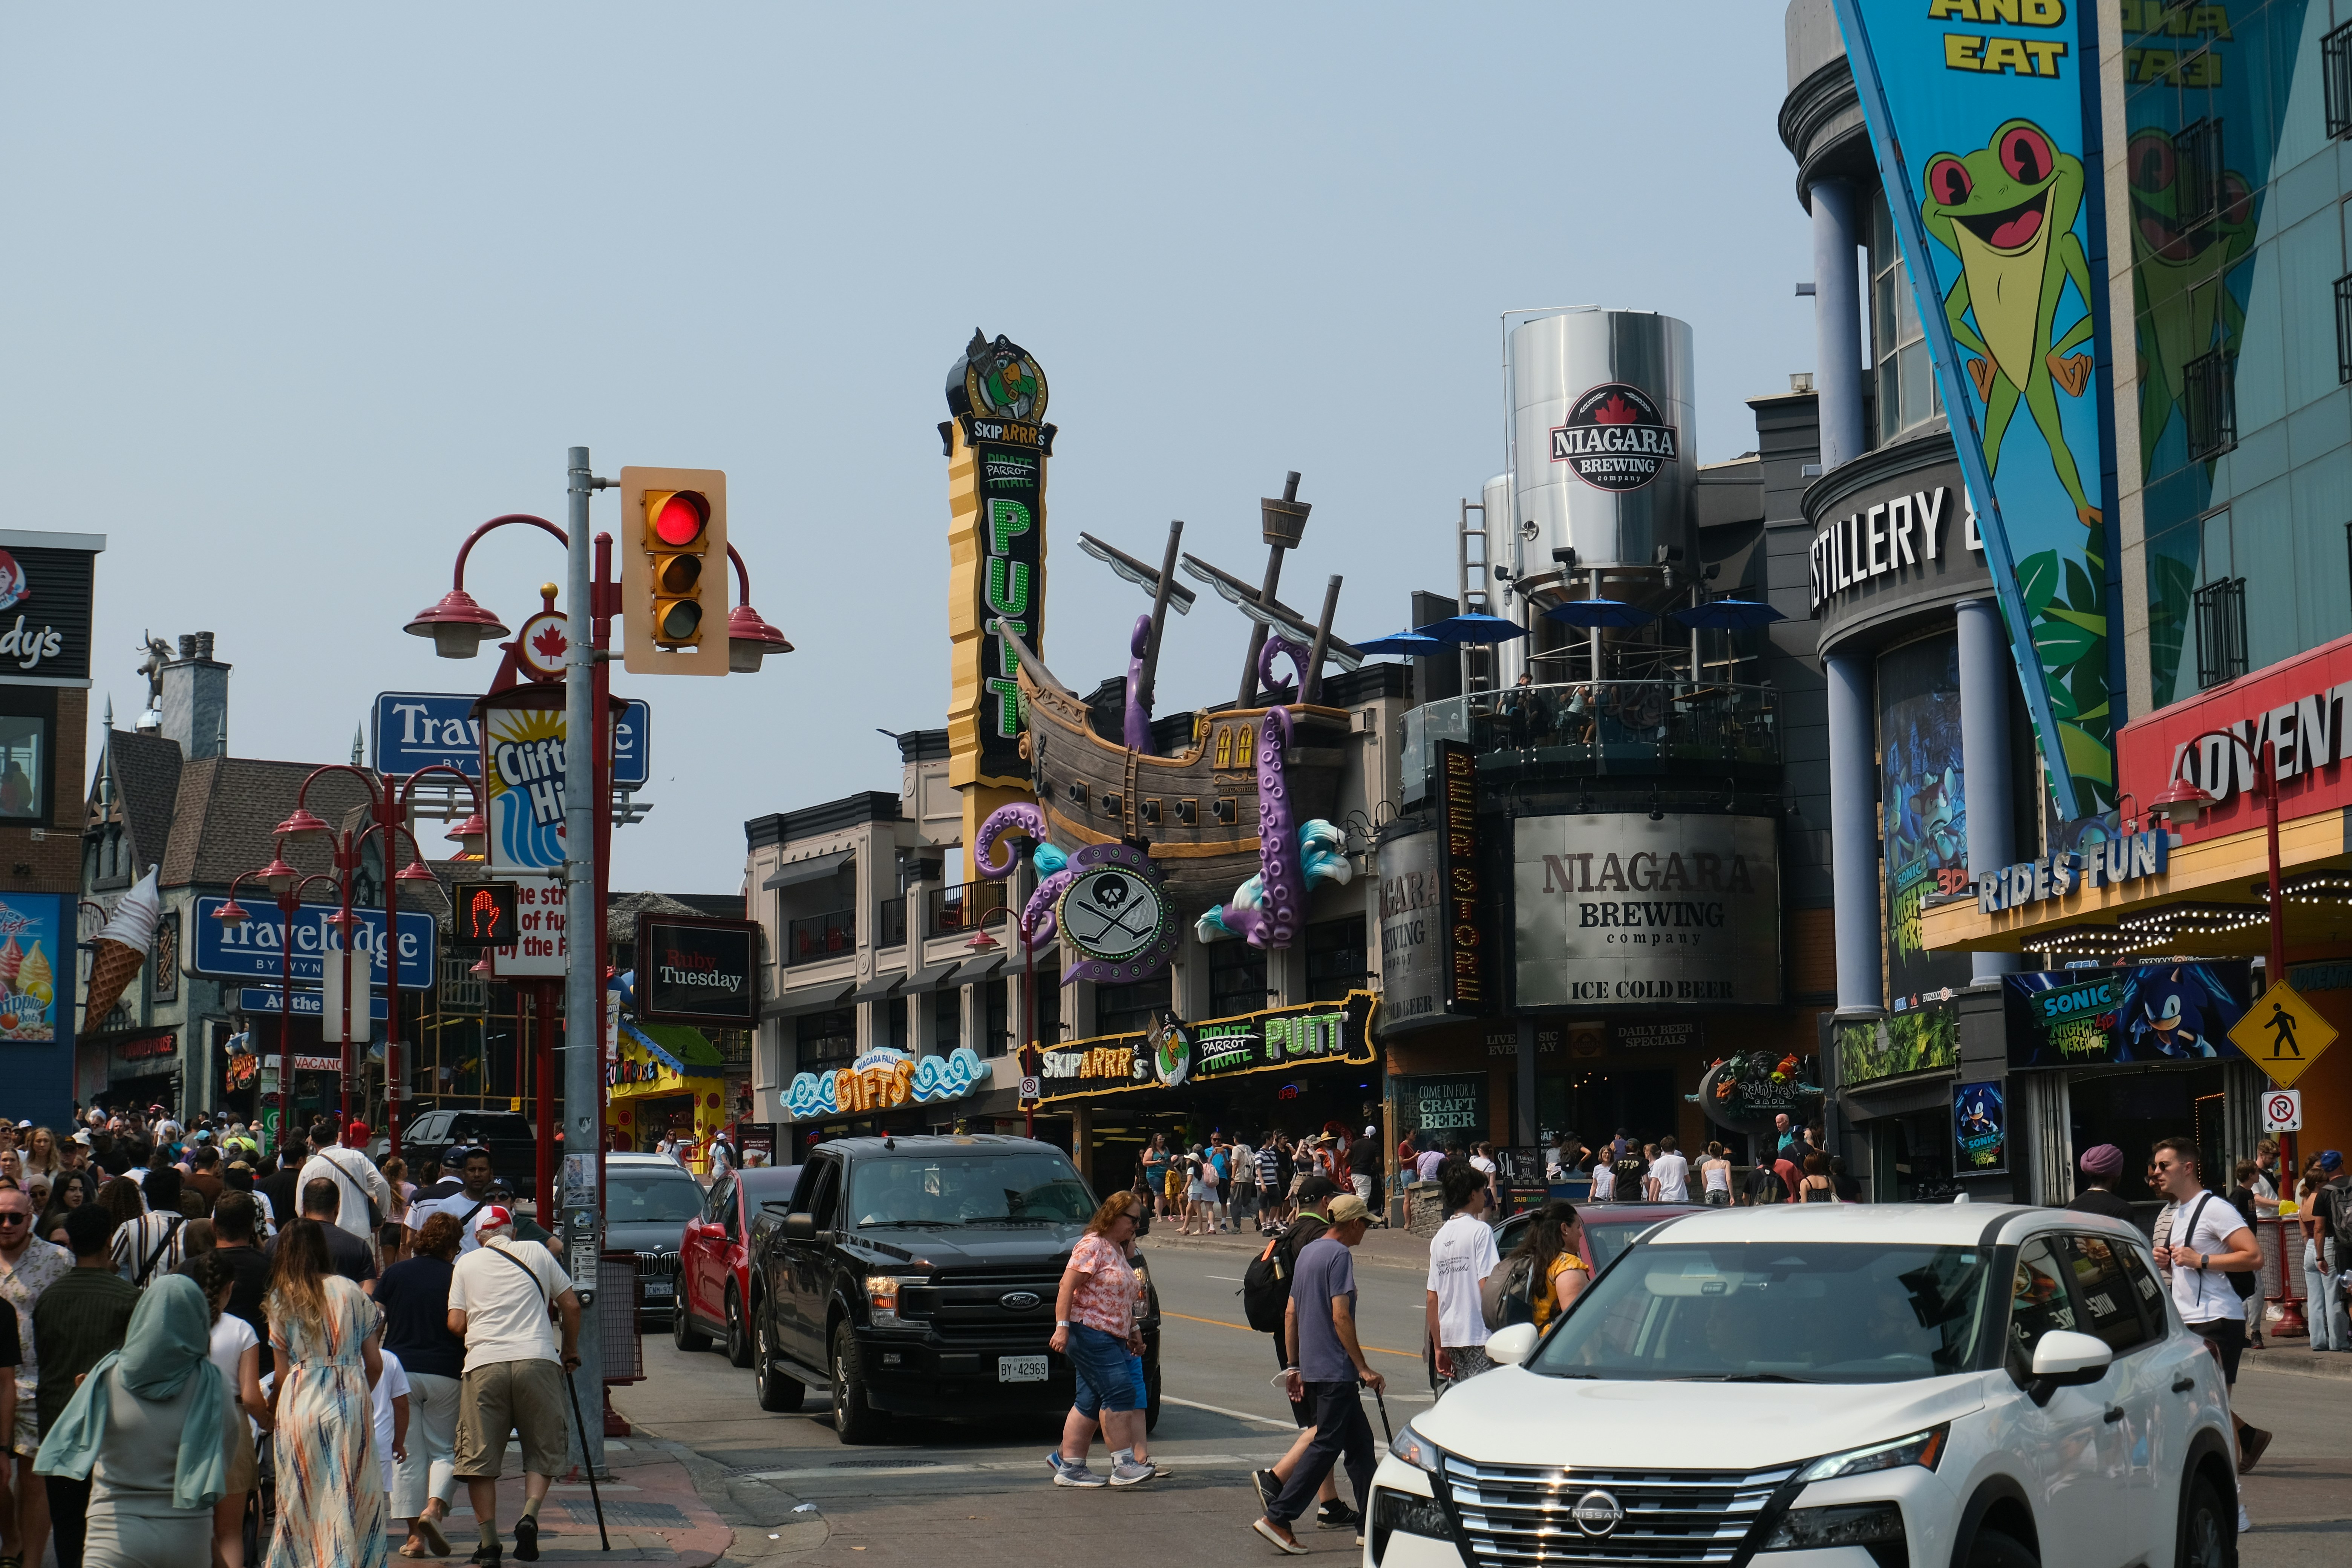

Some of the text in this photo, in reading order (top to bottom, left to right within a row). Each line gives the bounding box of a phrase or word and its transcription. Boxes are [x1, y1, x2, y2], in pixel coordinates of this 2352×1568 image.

[1928, 0, 2066, 27] AND
[1943, 33, 2068, 78] EAT
[1554, 427, 1675, 456] NIAGARA
[986, 465, 1028, 476] PARROT
[1580, 458, 1655, 473] BREWING
[986, 498, 1031, 739] PUTT
[444, 759, 464, 770] BY
[498, 736, 566, 786] Clift
[530, 779, 566, 824] Hi
[1449, 752, 1475, 856] BEER
[2089, 829, 2164, 889] FUN
[1542, 852, 1755, 894] NIAGARA
[1898, 861, 1922, 888] SONIC
[1937, 868, 1968, 896] 3D
[541, 885, 566, 905] str
[1892, 881, 1938, 927] NIGHT
[522, 910, 565, 931] of fu
[1579, 902, 1725, 928] BREWING
[1452, 867, 1480, 1001] STORE
[1607, 933, 1701, 946] company
[523, 936, 553, 957] the
[256, 959, 275, 970] BY
[665, 949, 717, 973] Ruby
[660, 966, 742, 992] Tuesday
[1572, 980, 1734, 999] ICE COLD BEER
[0, 992, 45, 1015] ippin'
[292, 996, 320, 1011] the
[1403, 995, 1433, 1015] BEER
[2044, 984, 2112, 1017] SONIC
[1265, 1011, 1348, 1060] PUTT
[1487, 1031, 1558, 1044] LIVE SIC
[1618, 1023, 1694, 1037] DAILY BEER
[2049, 1019, 2095, 1038] NIGHT
[1201, 1038, 1246, 1055] PARROT
[1539, 1042, 1557, 1052] AY
[1626, 1035, 1686, 1047] SPECIALS
[2057, 1034, 2110, 1058] WEREHOG
[295, 1057, 342, 1070] VACANC
[857, 1054, 898, 1072] NIAGARA FALLS
[834, 1060, 914, 1112] GIFTS
[1278, 1087, 1297, 1099] OPEN
[1419, 1083, 1476, 1099] COME IN FOR A
[1739, 1080, 1798, 1099] Rainforest
[264, 1095, 280, 1103] OPE
[1419, 1098, 1476, 1113] CRAFT
[1420, 1112, 1476, 1129] BEER
[1968, 1134, 1996, 1149] SONIC
[1617, 1160, 1639, 1170] FTP
[1011, 1295, 1031, 1305] Ford
[1001, 1363, 1046, 1376] BY 42969
